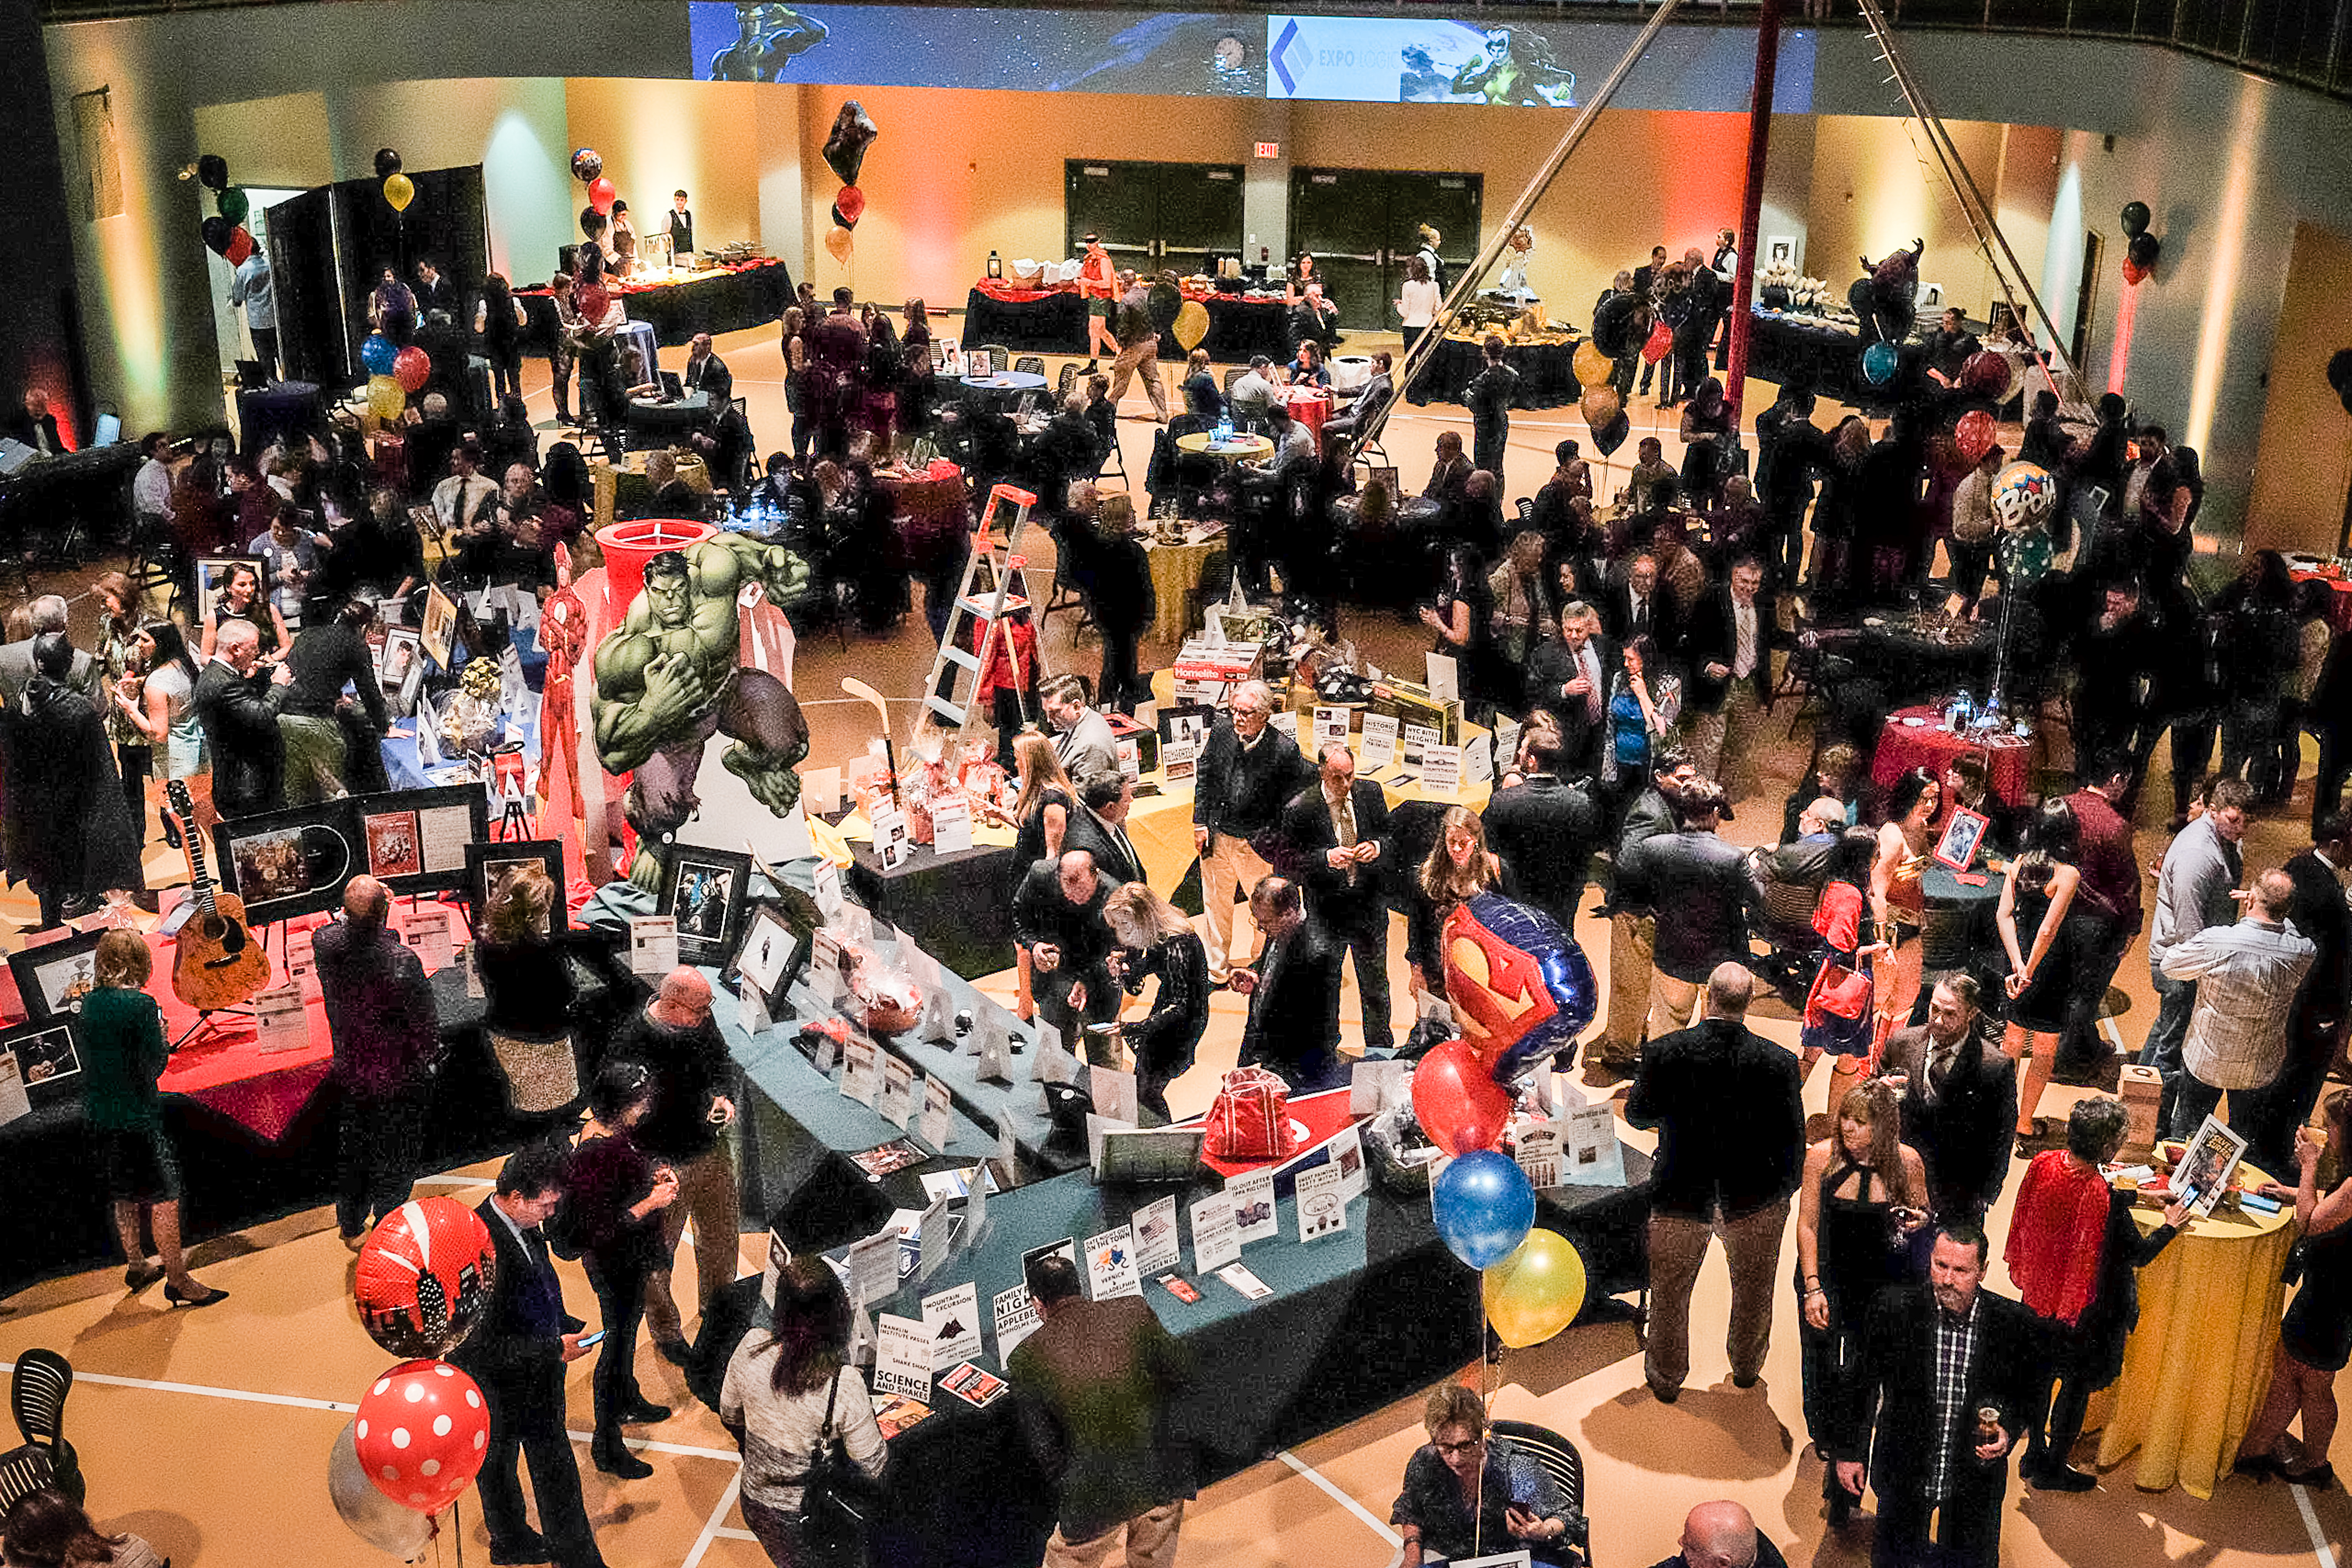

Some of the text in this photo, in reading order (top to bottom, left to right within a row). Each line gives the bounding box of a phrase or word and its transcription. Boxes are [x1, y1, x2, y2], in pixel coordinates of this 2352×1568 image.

[1319, 49, 1401, 70] EXPO LOGIC
[1258, 143, 1277, 157] EXIT
[1174, 666, 1219, 679] Homelite
[1365, 720, 1395, 730] HISTORIC
[1406, 735, 1437, 745] HEIGHTS
[2207, 1140, 2232, 1160] SURFER
[2212, 1134, 2235, 1153] SILVER
[1252, 1176, 1270, 1185] AFTER
[1097, 1238, 1109, 1249] THE
[1110, 1232, 1130, 1243] TOWN
[1140, 1256, 1178, 1276] XPERIENCE
[1101, 1271, 1125, 1283] VERNICK
[995, 1287, 1022, 1306] FAMILY
[1096, 1280, 1136, 1298] PHILADELPHIA
[998, 1308, 1036, 1330] APPLEBE
[880, 1324, 909, 1334] FRANKLIN
[880, 1329, 909, 1340] INSTITUTE
[893, 1357, 931, 1371] SHAKE SHACK
[877, 1370, 929, 1392] SCIENCE
[876, 1381, 928, 1401] AND SHAKES
